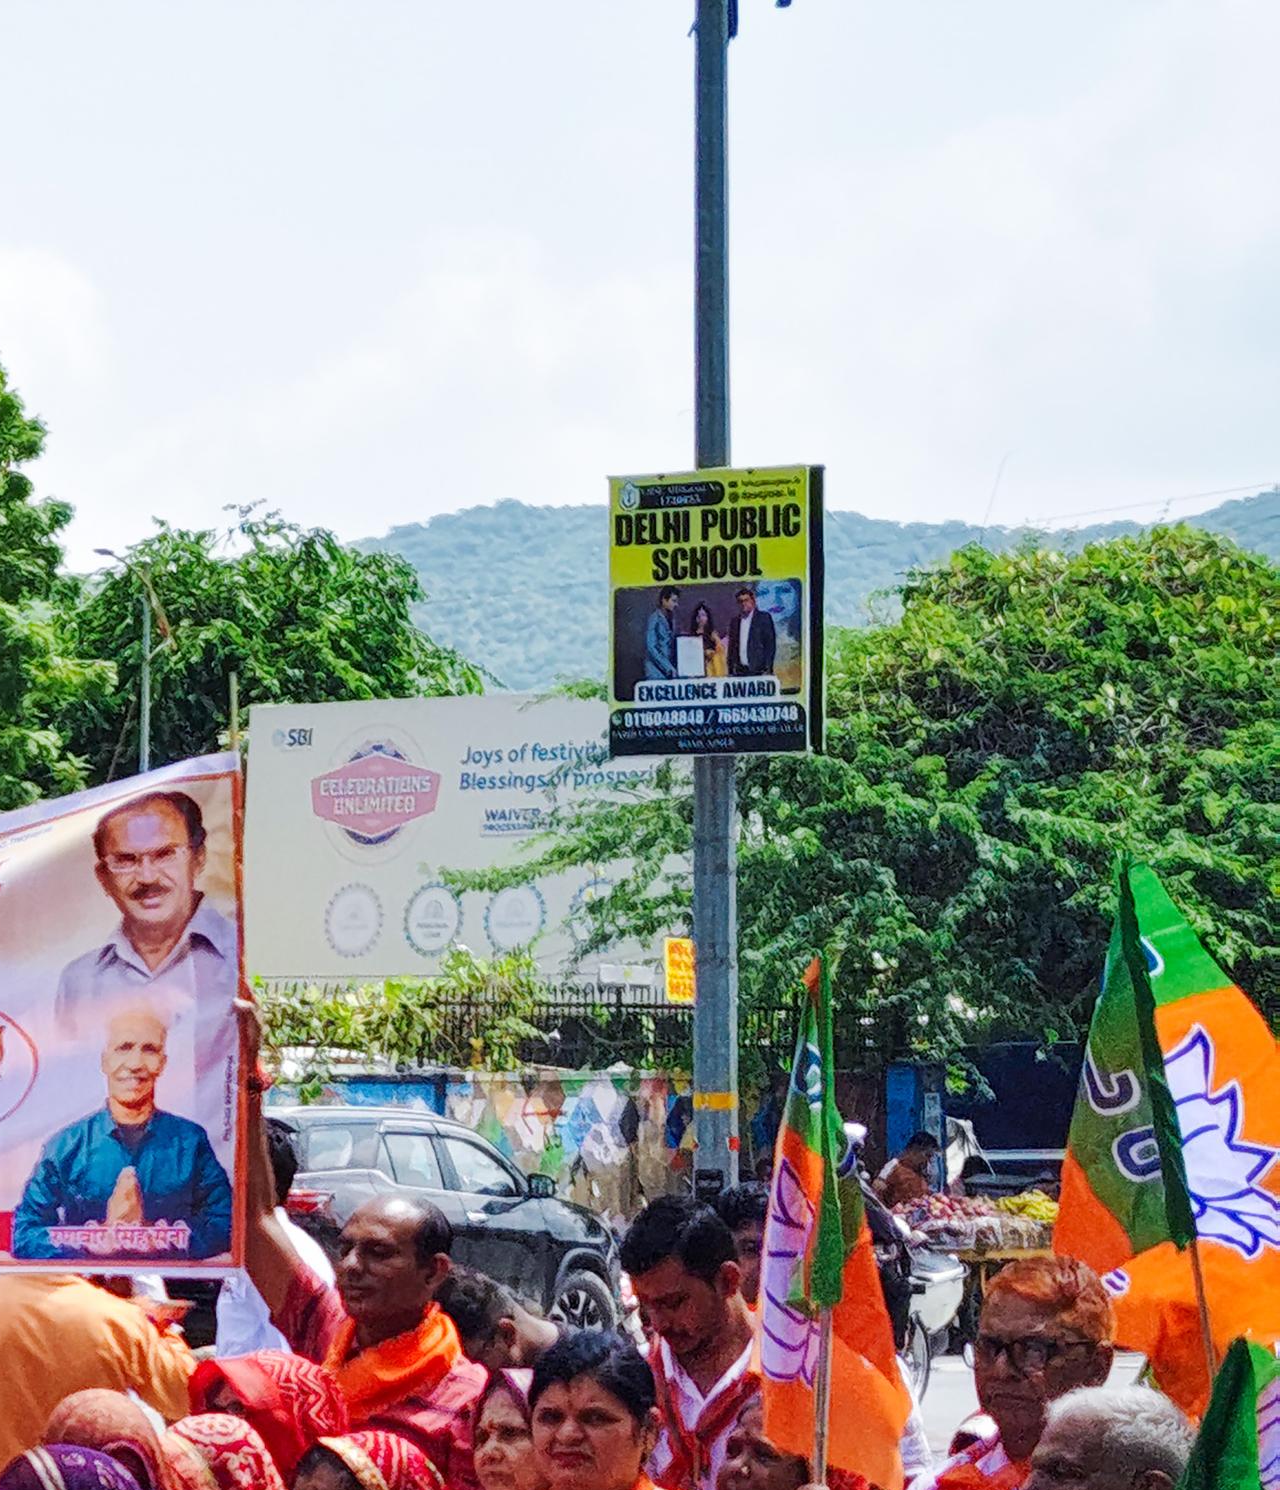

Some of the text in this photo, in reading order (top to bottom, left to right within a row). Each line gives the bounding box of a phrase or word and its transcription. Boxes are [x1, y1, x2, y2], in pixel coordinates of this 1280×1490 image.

[615, 502, 802, 547] DELHI PUBLIC
[652, 543, 763, 582] SCHOOL
[638, 679, 777, 702] EXCELLENCE AWARD
[286, 728, 314, 747] SBI
[460, 746, 503, 769] Joys
[508, 743, 528, 765] of
[319, 775, 433, 796] CELEBRATIONS
[459, 772, 548, 793] Blessings
[333, 796, 417, 816] UNLIMITED
